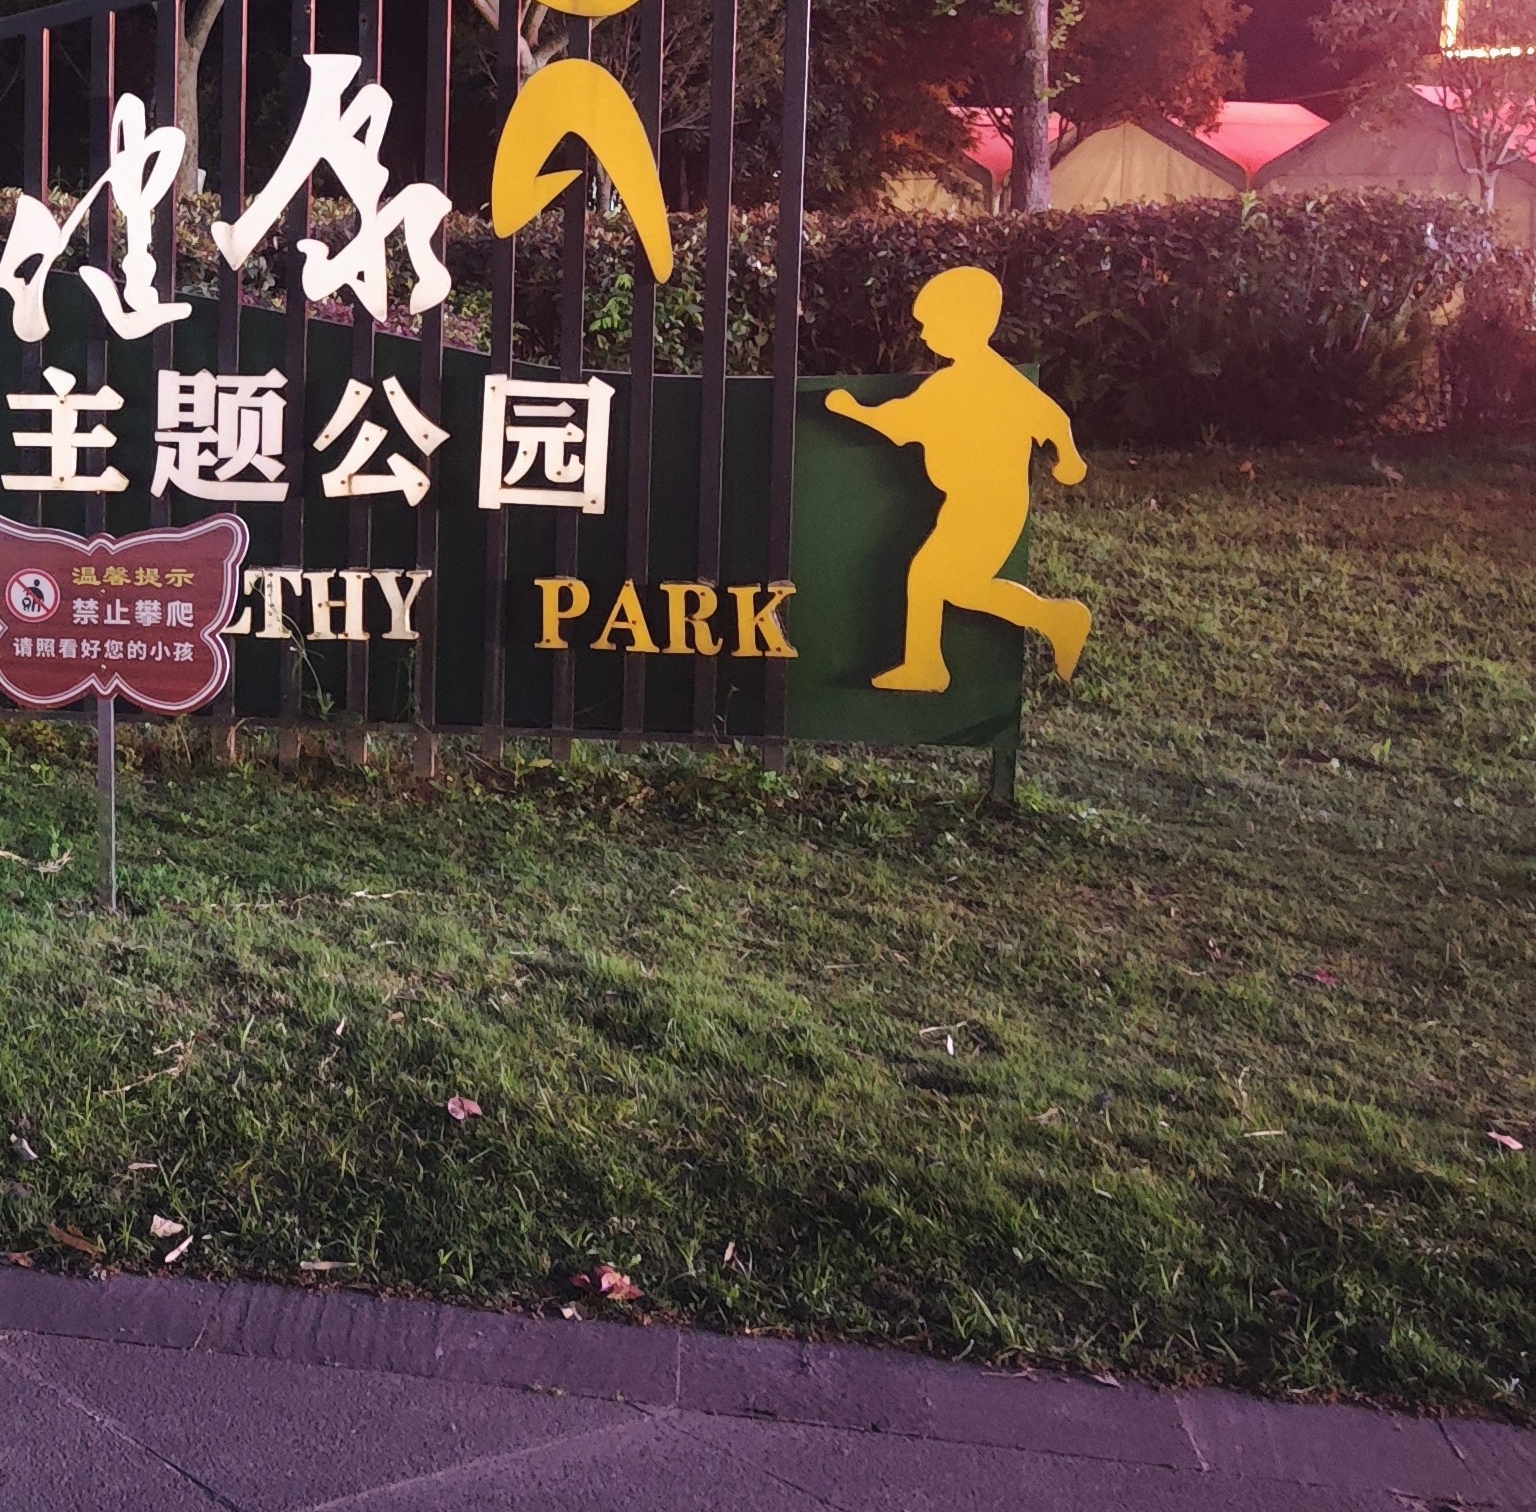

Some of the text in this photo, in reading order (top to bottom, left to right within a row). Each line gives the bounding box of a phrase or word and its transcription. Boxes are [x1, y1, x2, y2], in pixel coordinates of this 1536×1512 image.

[0, 366, 616, 515] 主题公园
[72, 566, 195, 588] 温馨提示
[71, 597, 195, 629] 禁止攀爬
[534, 574, 799, 658] PARK
[12, 636, 195, 662] 请照看好您的小孩
